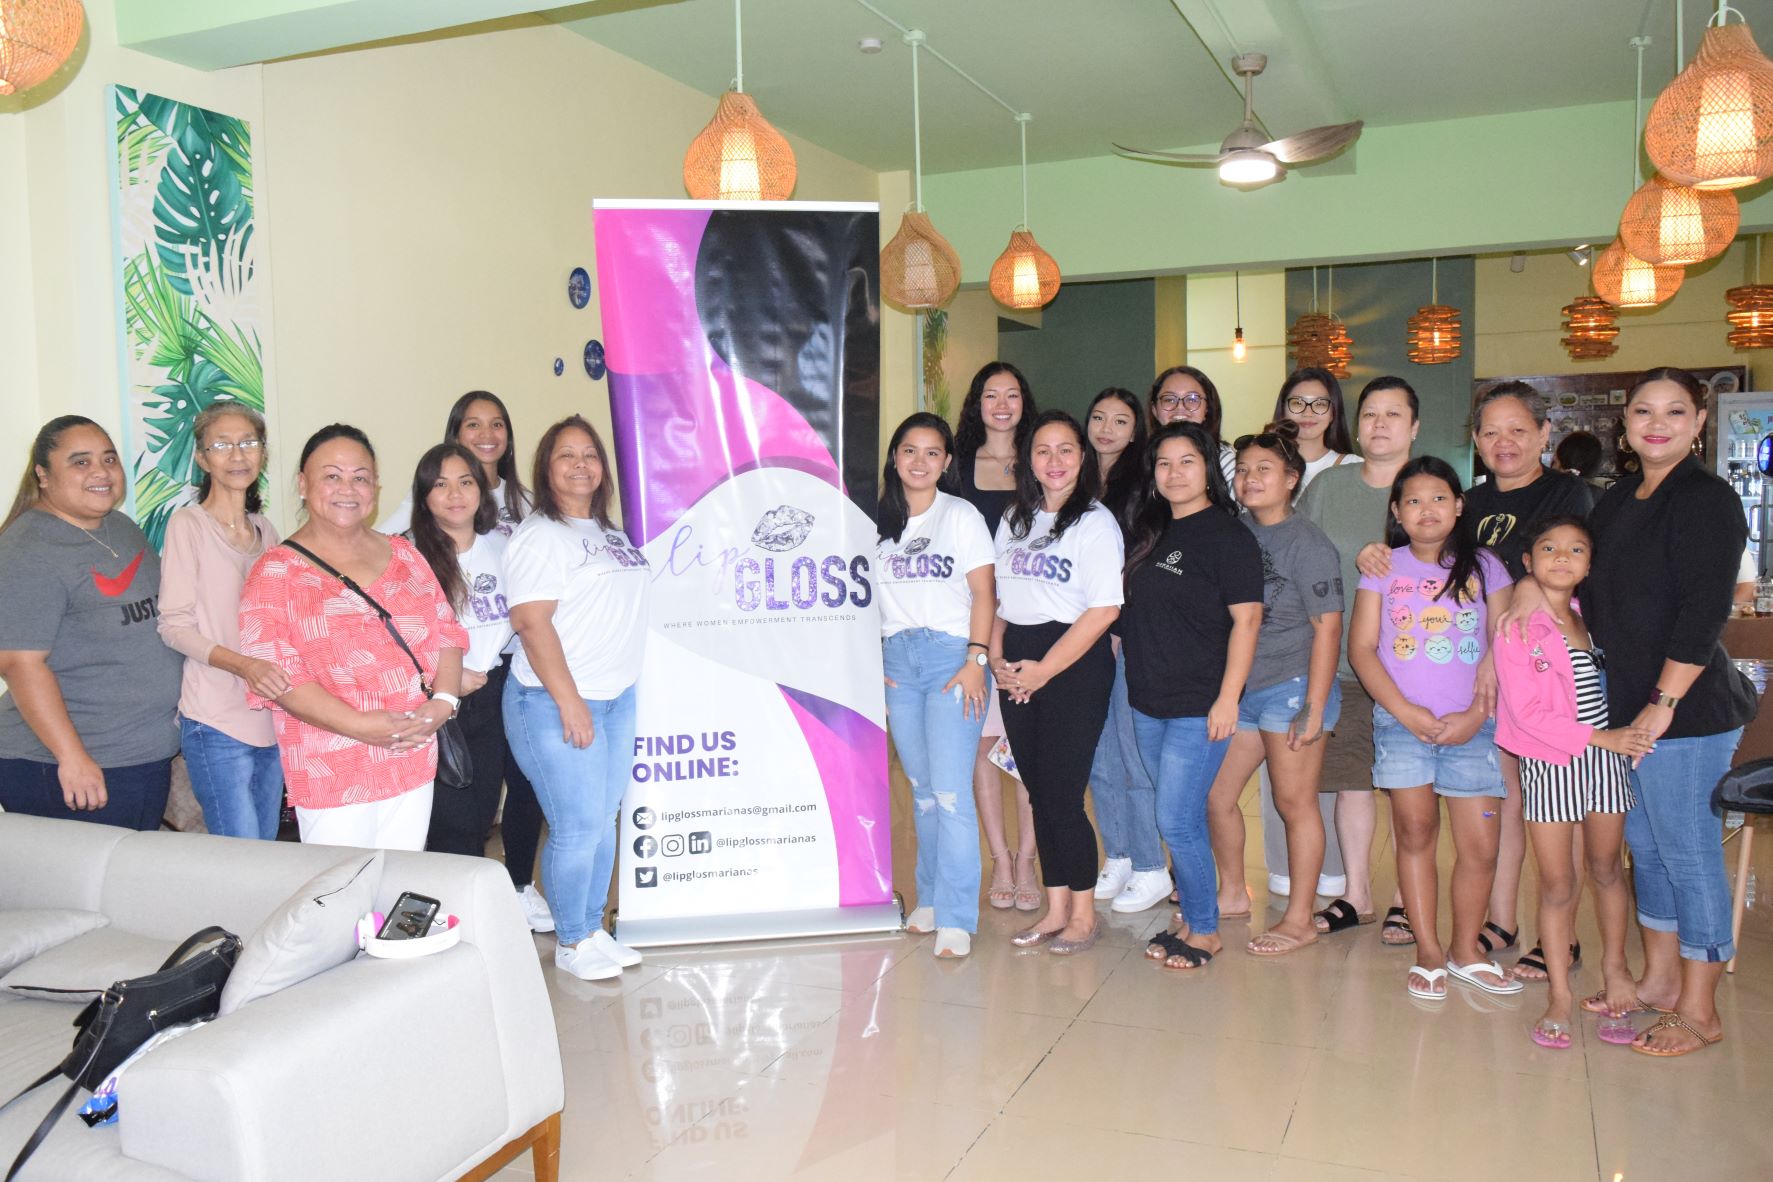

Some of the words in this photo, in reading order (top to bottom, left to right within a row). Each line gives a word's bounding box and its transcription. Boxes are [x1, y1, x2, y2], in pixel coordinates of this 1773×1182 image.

[610, 547, 650, 567] GLO
[651, 525, 751, 595] lip
[892, 554, 955, 579] GLOSS
[1011, 550, 1073, 583] GLOSS
[734, 554, 873, 611] GLOSS
[1386, 579, 1414, 596] love
[121, 597, 156, 626] JUST
[471, 593, 510, 622] GLO
[663, 621, 693, 630] WHERE
[697, 619, 729, 628] WOMEN
[731, 616, 797, 626] EMPOWERMENT
[800, 614, 857, 623] TRANSCENDS
[633, 734, 695, 756] FIND
[701, 730, 737, 752] US
[632, 757, 739, 783] ONLINE:
[661, 803, 817, 823] lipglossmarianas@gmail.com
[715, 834, 817, 848] @lipglossmarianas
